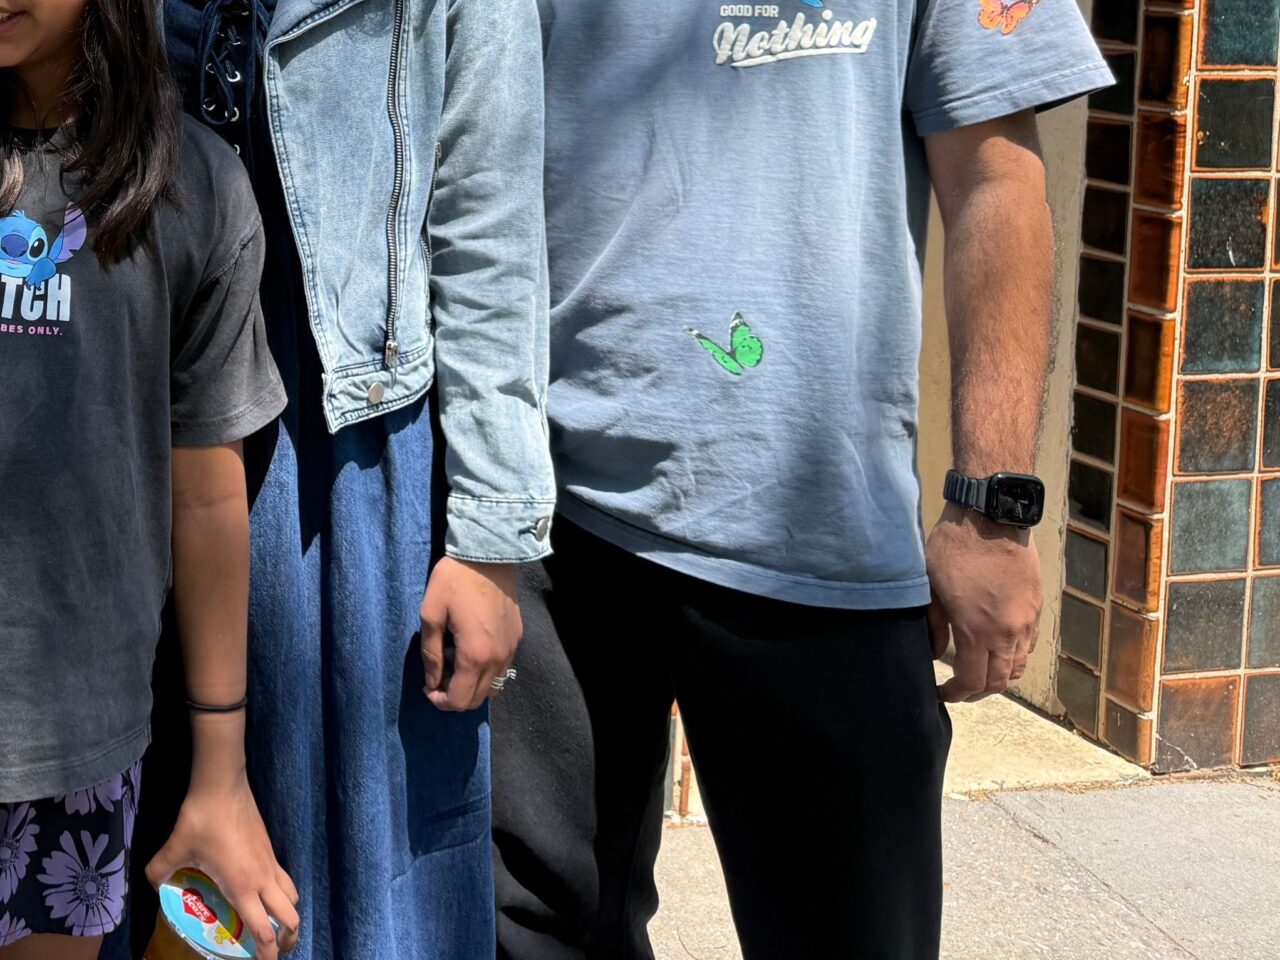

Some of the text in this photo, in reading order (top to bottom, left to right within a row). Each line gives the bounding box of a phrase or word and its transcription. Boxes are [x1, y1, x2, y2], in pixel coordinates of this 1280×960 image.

[720, 5, 779, 17] GOOD FOR
[713, 9, 878, 68] Nothing
[28, 326, 63, 336] ONLY.
